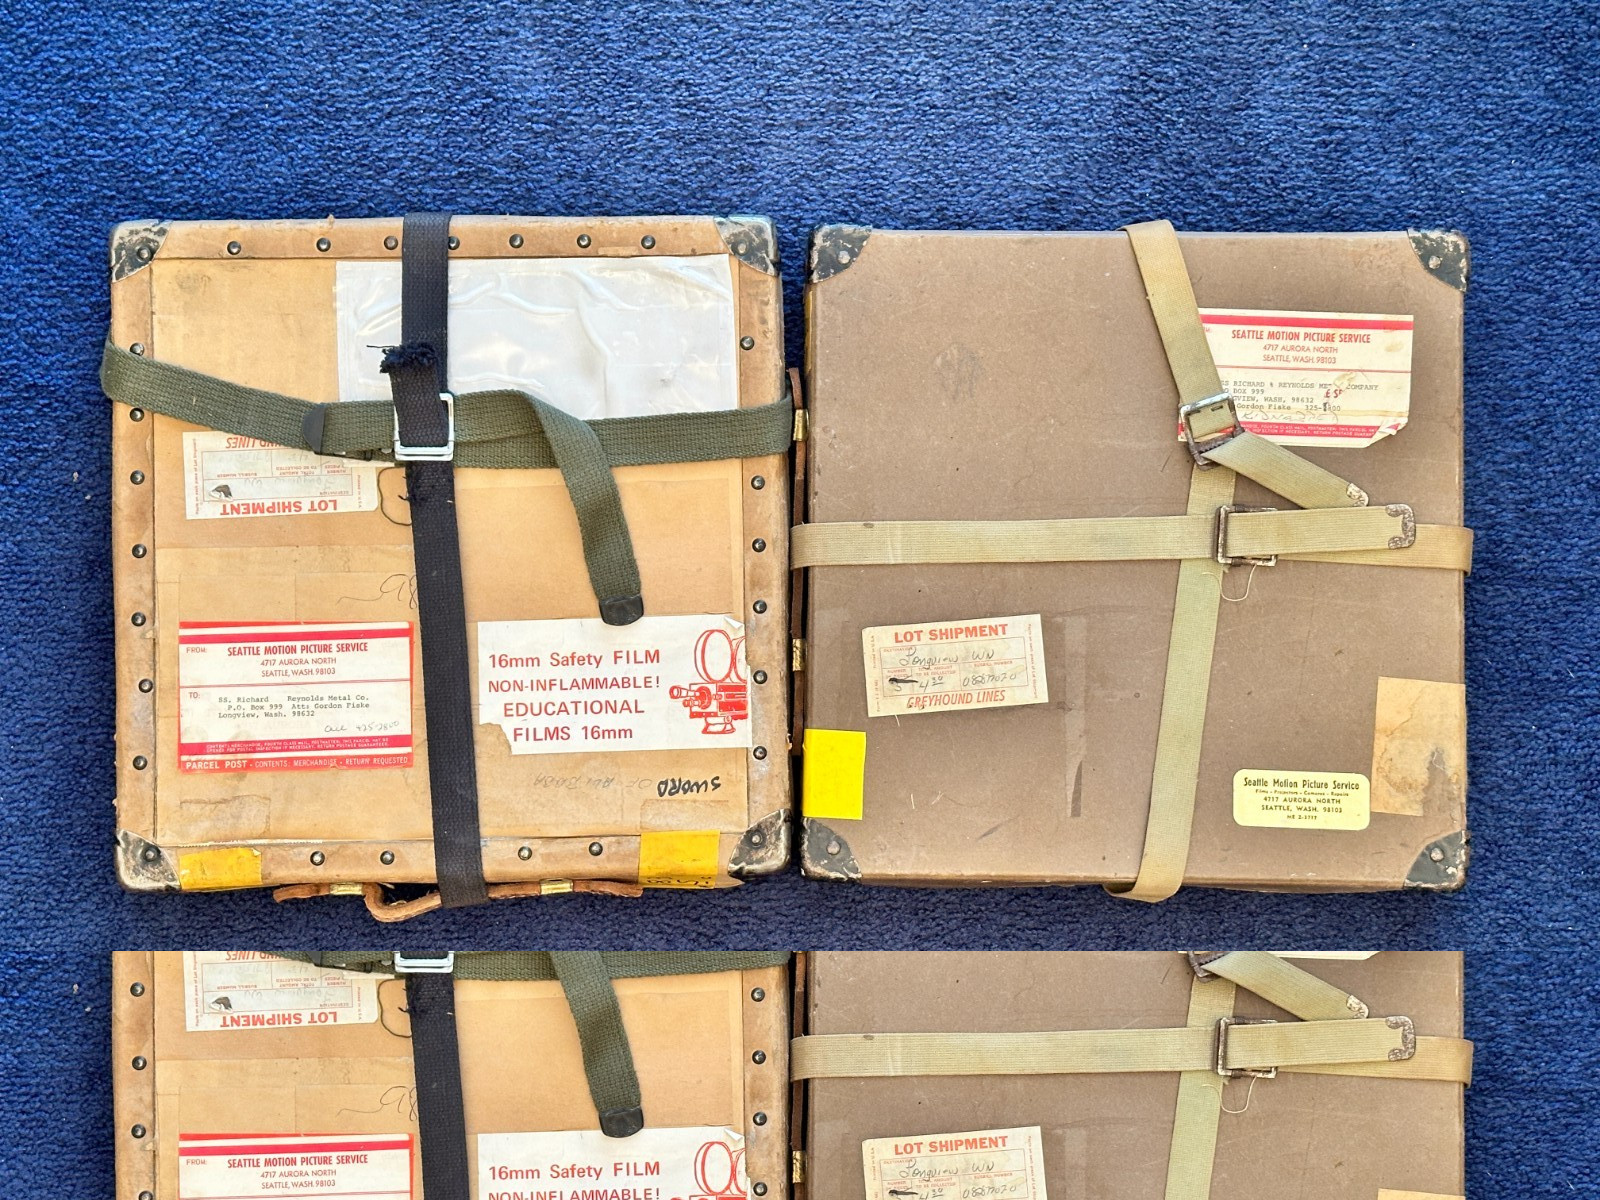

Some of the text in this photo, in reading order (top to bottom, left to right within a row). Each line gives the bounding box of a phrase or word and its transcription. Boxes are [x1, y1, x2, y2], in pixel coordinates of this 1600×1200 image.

[1232, 330, 1371, 343] SEATTLE MOTION PICTURE SERVICE
[1316, 356, 1337, 364] 98103
[220, 500, 337, 516] LOT SHIPMENT
[895, 624, 1008, 643] LOT SHIPMENT
[228, 642, 368, 656] SEATTLE MOTION PICTURE SERVICE
[312, 657, 337, 665] NORTH
[489, 649, 660, 669] 16mm Safety FILM
[262, 670, 290, 678] SEATTLE,
[488, 675, 660, 693] NON-INFLAMMABLE!
[287, 695, 324, 703] Reynolds
[907, 690, 1006, 710] GREYHOUND LINES
[504, 699, 645, 717] EDUCATIONAL
[514, 726, 633, 742] FILMS 16mm
[186, 762, 220, 770] PARCEL
[225, 760, 248, 768] POST
[255, 760, 290, 768] CONTENTS:
[293, 759, 337, 767] MERCHANDISE
[373, 756, 408, 764] REQUESTED
[657, 776, 722, 798] SWORD
[1244, 777, 1360, 790] Seattle Motion Picture Service
[220, 1012, 337, 1028] LOT SHIPMENT
[895, 1136, 1008, 1155] LOT SHIPMENT
[228, 1154, 368, 1168] SEATTLE MOTION PICTURE SERVICE
[312, 1169, 337, 1177] NORTH
[489, 1161, 660, 1181] 16mm Safety FILM
[262, 1182, 290, 1190] SEATTLE,
